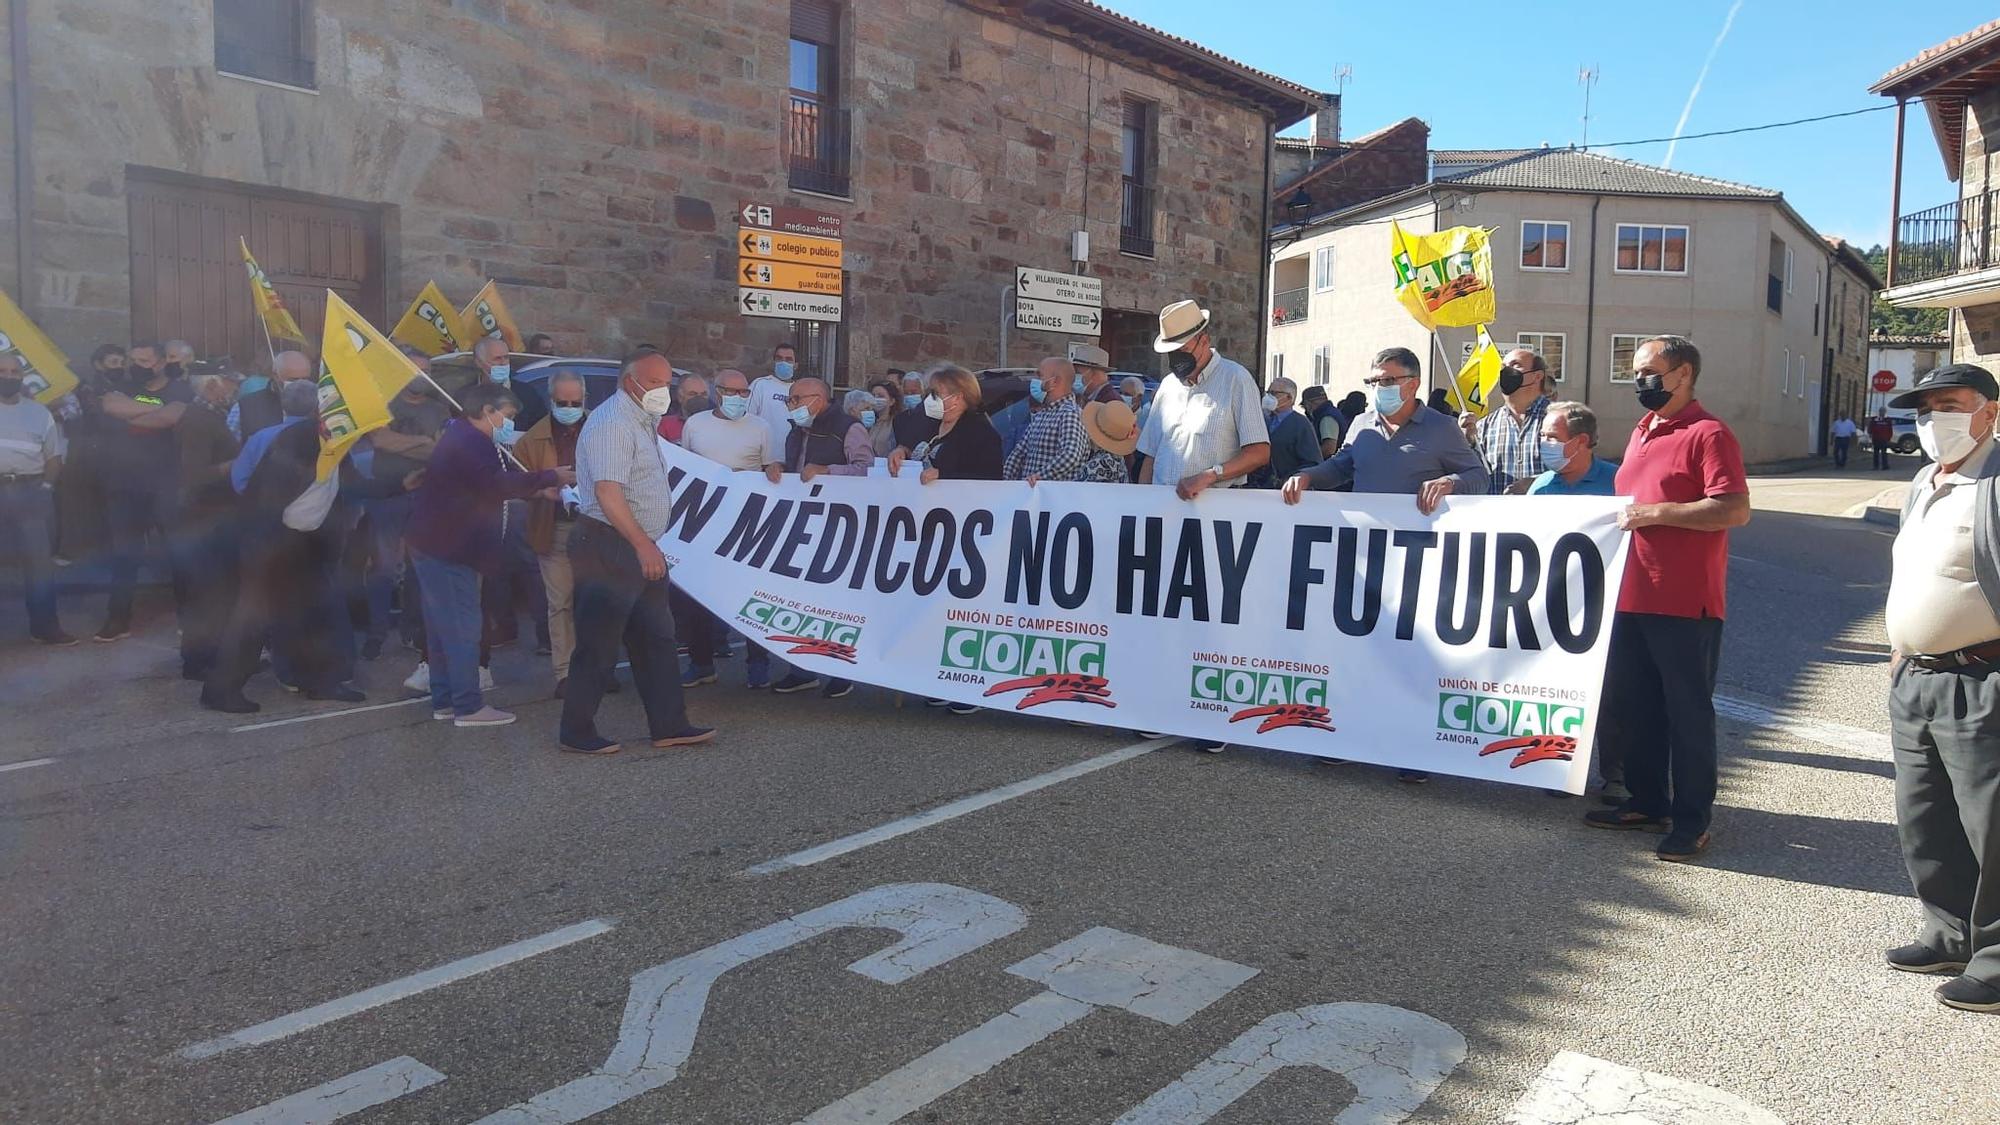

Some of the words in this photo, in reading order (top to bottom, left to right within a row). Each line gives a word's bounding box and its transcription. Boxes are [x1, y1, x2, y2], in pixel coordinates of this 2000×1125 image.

[818, 215, 840, 225] centro
[785, 223, 840, 236] medioambiental
[777, 242, 807, 255] colegio
[810, 247, 839, 258] publico
[816, 271, 840, 281] cuartel
[1035, 274, 1070, 286] VILLANUEVA
[798, 281, 824, 290] guardia
[826, 283, 840, 291] civil
[1056, 289, 1076, 298] OTERO
[777, 301, 806, 312] centro
[809, 303, 839, 315] medico
[1018, 302, 1034, 311] BOYA
[1018, 313, 1062, 327] ALCAÑICES
[715, 485, 994, 599] MÉDICOS
[1004, 510, 1094, 610] NO
[1115, 515, 1263, 625] HAY
[1286, 525, 1605, 654] FUTURO
[754, 590, 785, 605] UNIÓN
[788, 600, 802, 609] DE
[803, 605, 867, 624] CAMPESINOS
[734, 616, 769, 634] ZAMORA
[743, 600, 860, 645] COAG
[947, 609, 991, 624] UNIÓN
[995, 614, 1013, 627] DE
[1018, 616, 1109, 637] CAMPESINOS
[944, 628, 1103, 676] COAG
[1192, 651, 1228, 665] UNIÓN
[1231, 655, 1247, 666] DE
[1251, 657, 1330, 675] CAMPESINOS
[937, 670, 986, 686] ZAMORA
[1192, 667, 1325, 708] COAG
[1438, 677, 1478, 691] UNIÓN
[1482, 681, 1499, 693] DE
[1503, 683, 1587, 702] CAMPESINOS
[1190, 700, 1229, 713] ZAMORA
[1439, 694, 1583, 738] COAG
[1435, 732, 1480, 745] ZAMORA
